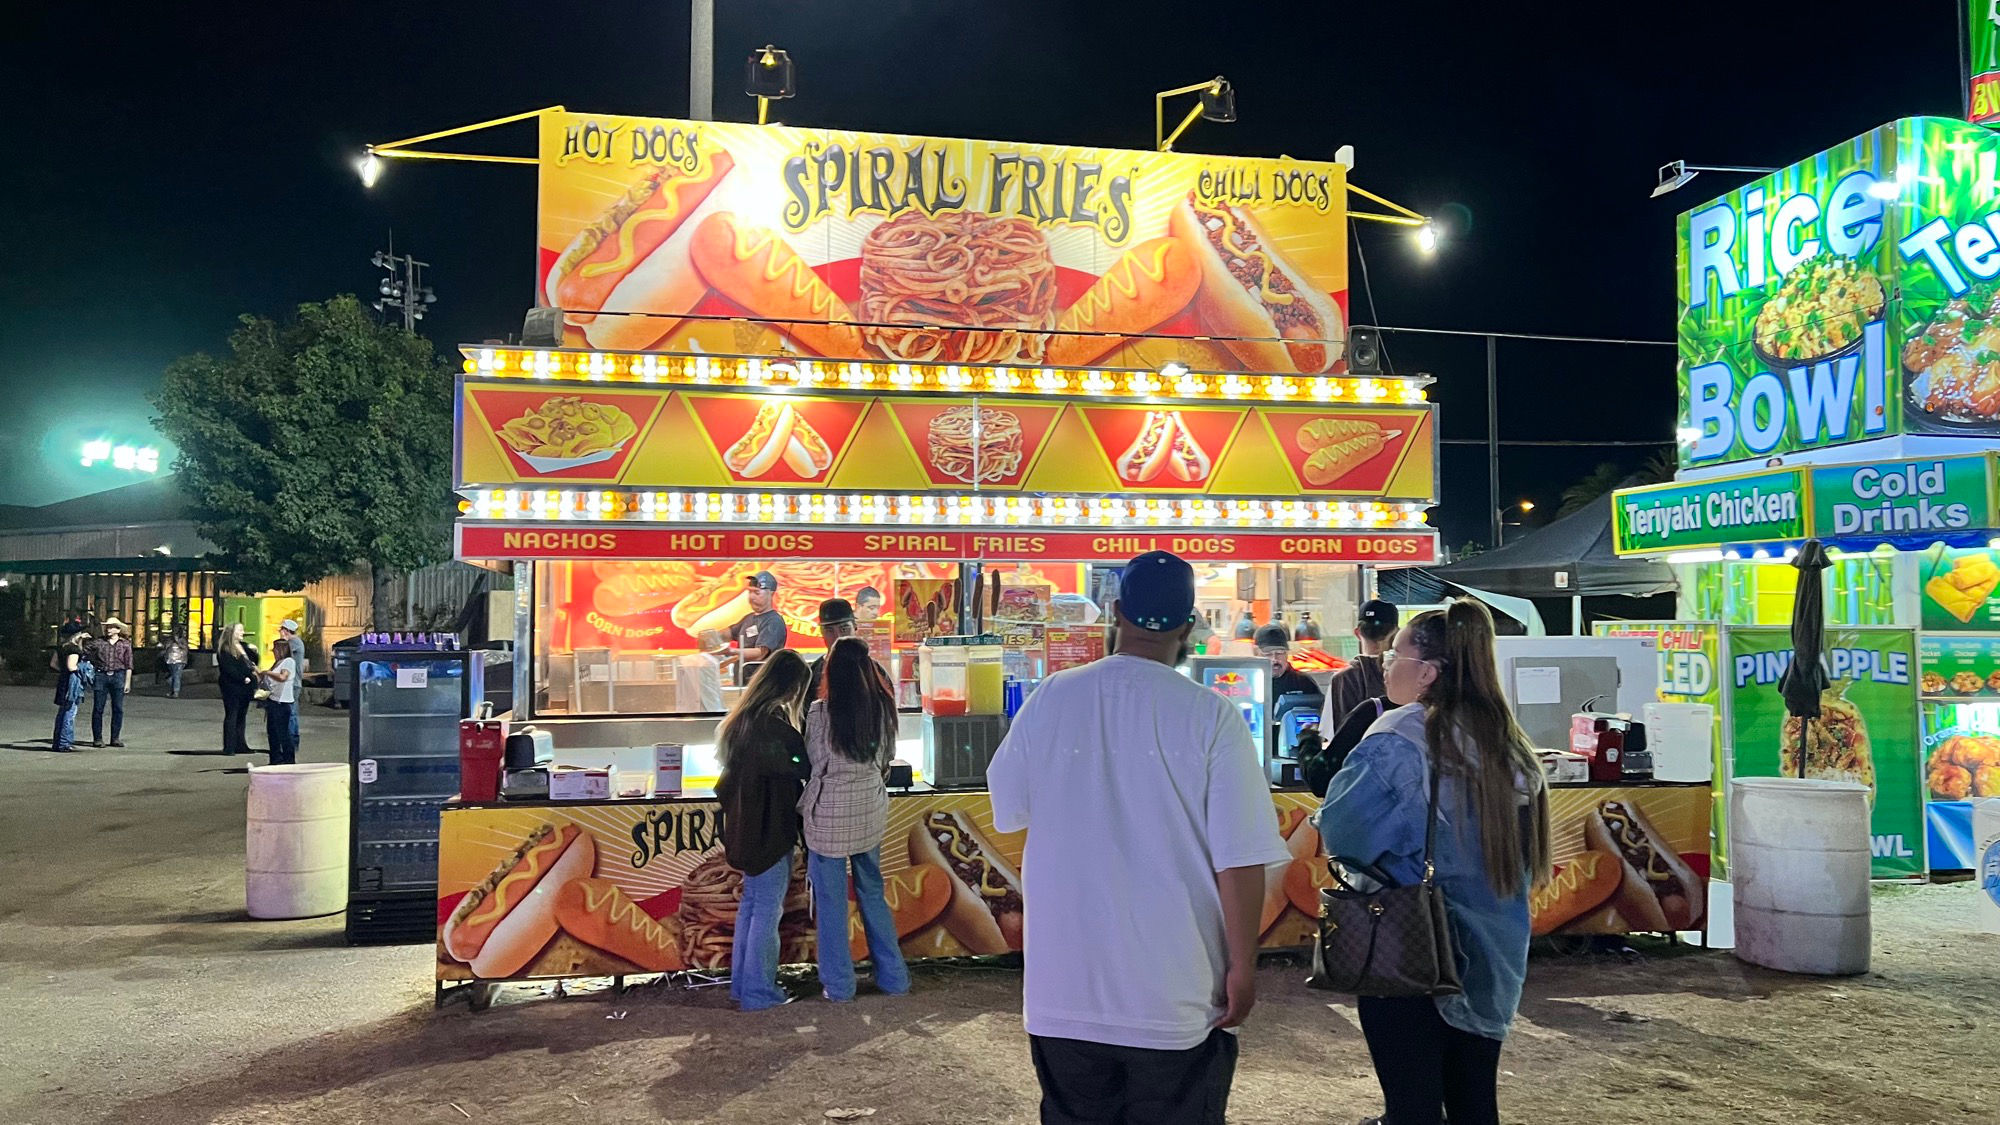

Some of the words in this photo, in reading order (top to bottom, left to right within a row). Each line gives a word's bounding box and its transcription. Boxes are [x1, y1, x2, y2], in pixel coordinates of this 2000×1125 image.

[560, 120, 627, 163] HOT
[631, 124, 701, 171] DOGS
[783, 141, 967, 229] SPIRAL
[990, 152, 1140, 243] FRIES
[1198, 166, 1262, 204] CHILI
[1272, 168, 1332, 210] DOGS
[1690, 170, 1884, 309] Rice
[1690, 320, 1886, 462] Bowl
[1852, 462, 1945, 499] Cold
[1626, 495, 1702, 538] Teriyaki
[1706, 488, 1796, 528] Chicken
[1833, 498, 1970, 534] Drinks
[503, 532, 617, 550] NACHOS
[671, 533, 726, 550] HOT
[743, 534, 814, 551] DOGS
[864, 535, 956, 551] SPIRAL
[973, 536, 1046, 553] FRIES
[1092, 538, 1157, 554] CHILI
[1172, 538, 1236, 554] DOGS
[1280, 538, 1342, 554] CORN
[1357, 539, 1418, 554] DOGS
[586, 612, 624, 636] CORN
[625, 626, 664, 638] DOGS
[1003, 633, 1025, 646] IES
[1662, 630, 1703, 650] CHILI
[1657, 650, 1712, 696] LED
[1735, 648, 1909, 688] PINPPLE
[631, 807, 726, 869] SPIRA
[1870, 833, 1914, 858] WL
